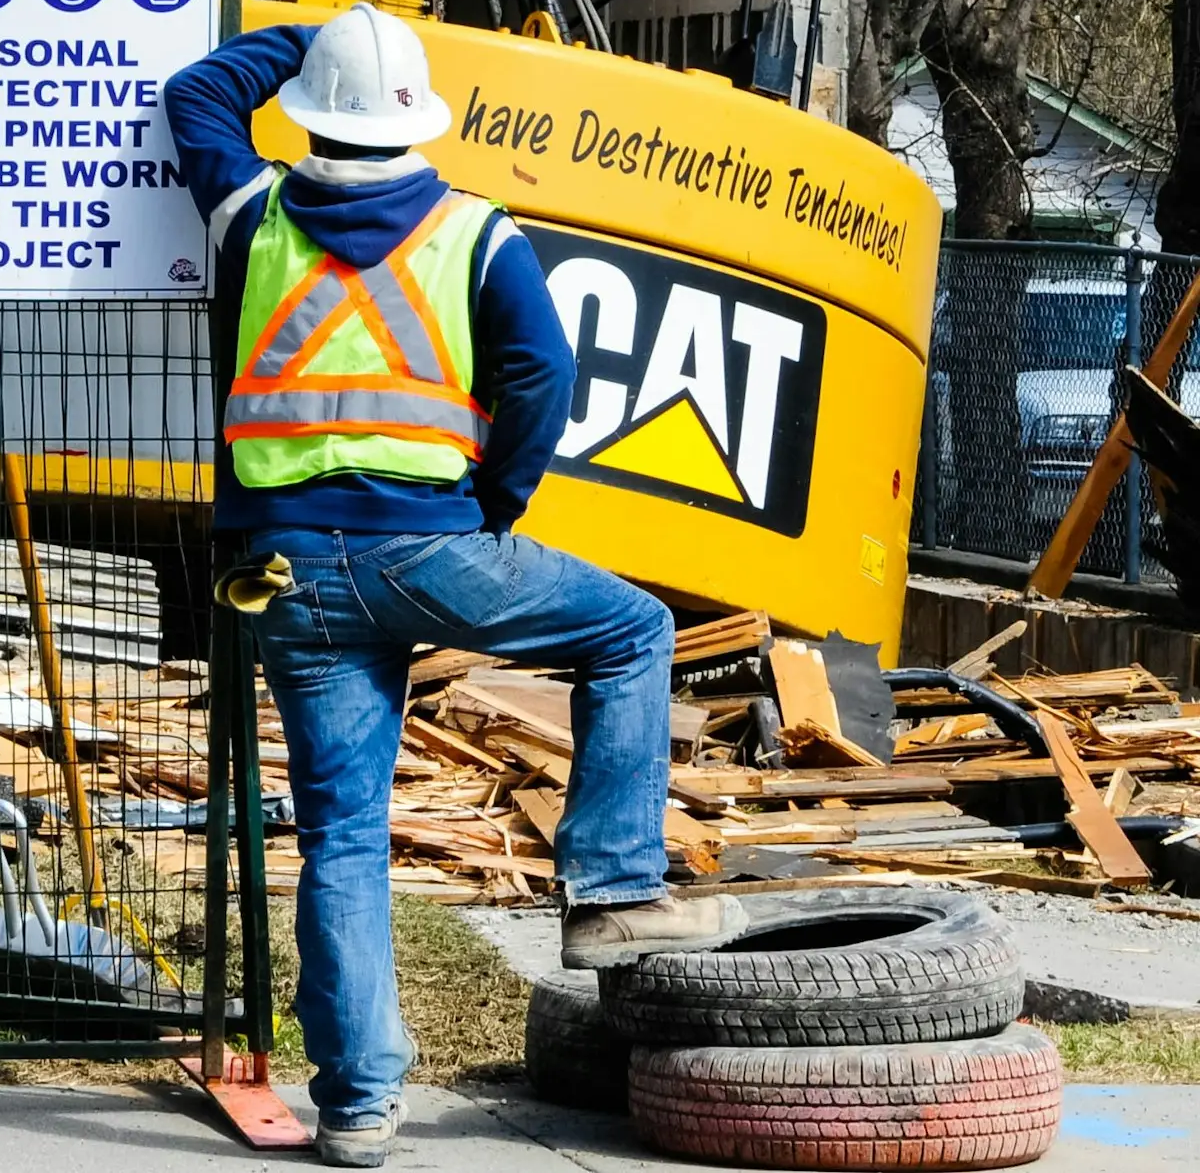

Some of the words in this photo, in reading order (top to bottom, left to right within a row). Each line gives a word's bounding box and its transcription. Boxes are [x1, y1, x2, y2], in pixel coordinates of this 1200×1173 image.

[12, 200, 110, 227] THIS
[63, 160, 187, 188] WORN
[461, 86, 553, 155] have
[571, 109, 772, 210] Destructive
[784, 167, 907, 273] Tendencies!
[544, 256, 804, 510] CAT
